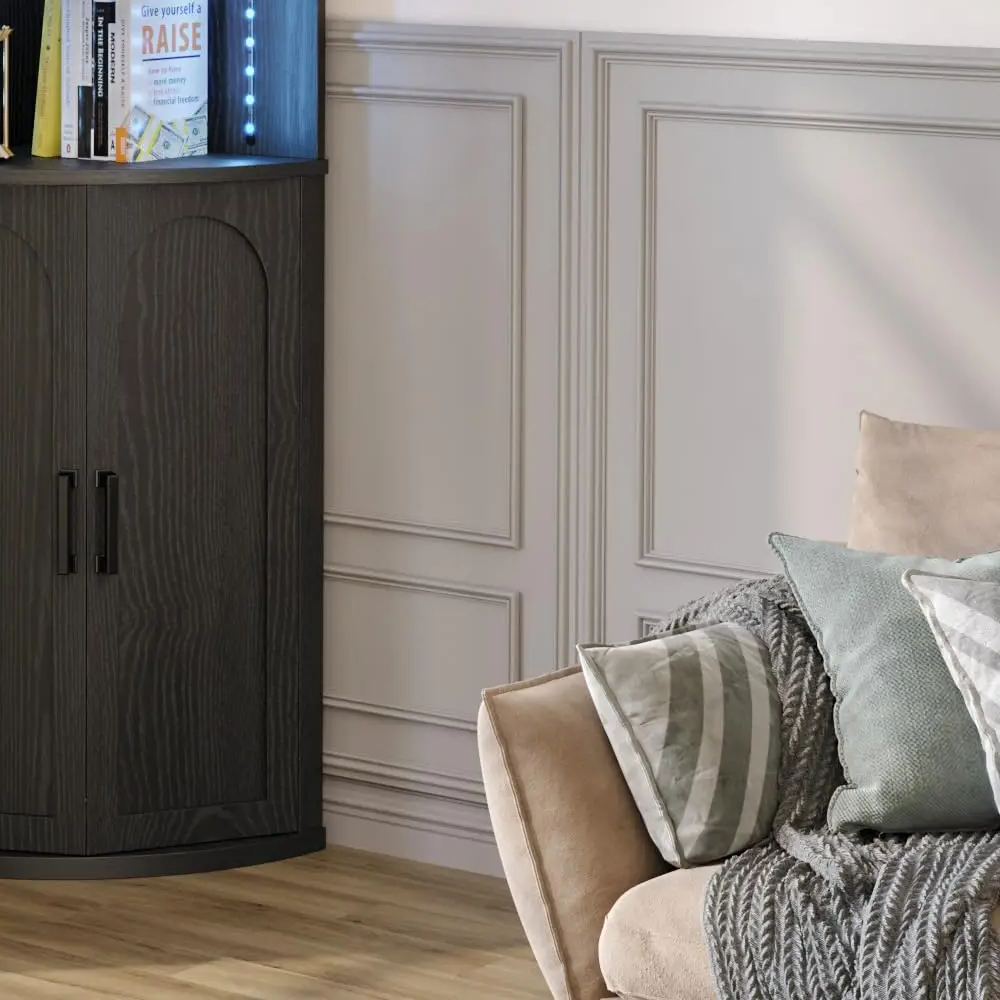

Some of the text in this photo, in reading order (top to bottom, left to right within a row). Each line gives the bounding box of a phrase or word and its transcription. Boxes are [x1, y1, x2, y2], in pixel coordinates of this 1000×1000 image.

[141, 2, 202, 19] Give yourself a
[97, 16, 104, 26] IN
[142, 22, 202, 55] RAISE
